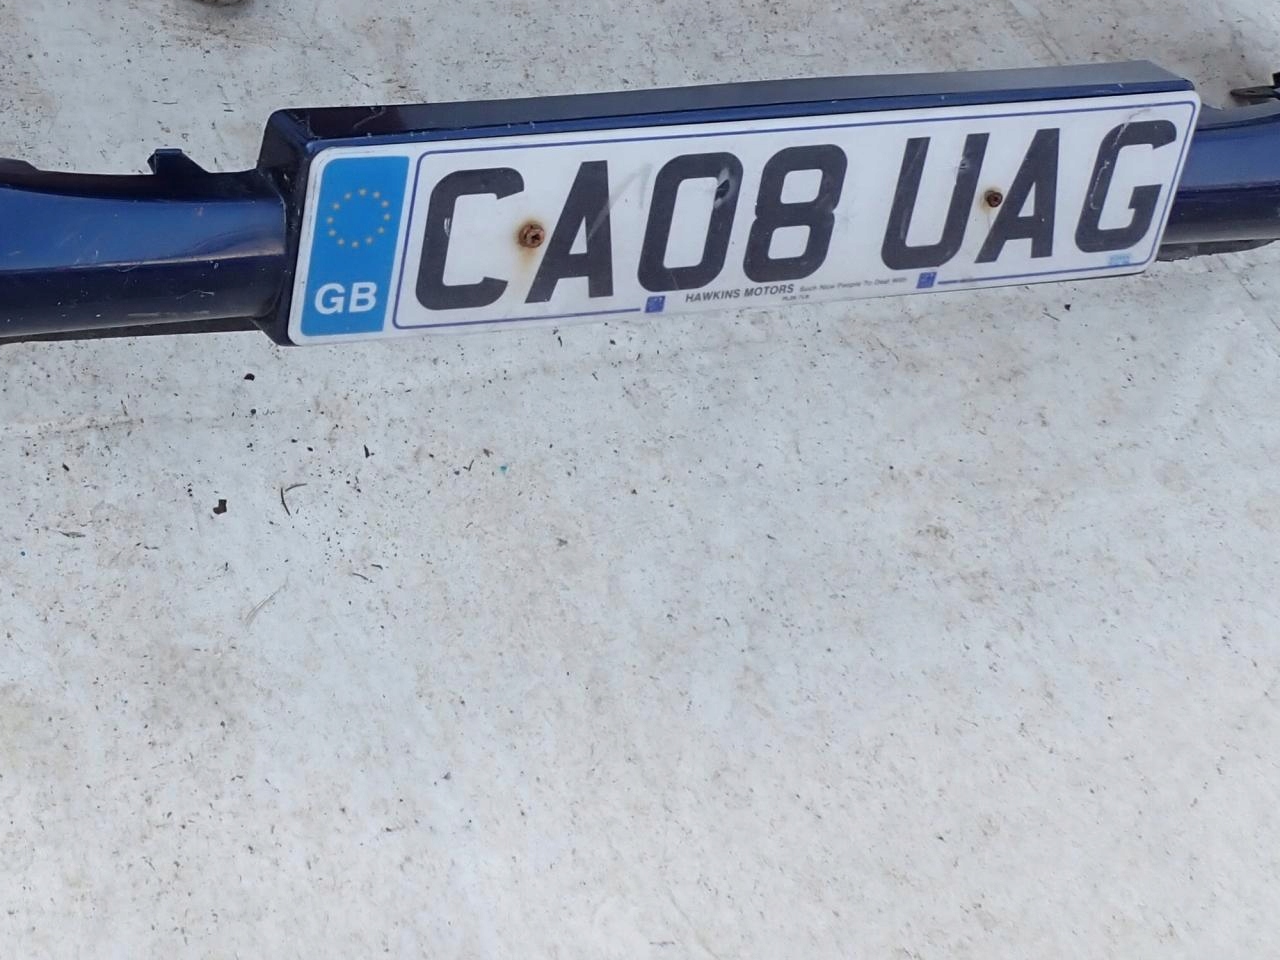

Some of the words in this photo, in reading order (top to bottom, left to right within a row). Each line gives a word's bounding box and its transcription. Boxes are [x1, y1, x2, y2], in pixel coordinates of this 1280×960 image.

[415, 143, 848, 310] CA08
[881, 119, 1178, 271] UAG
[314, 281, 378, 315] GB
[685, 289, 740, 303] HAWKINS
[744, 283, 795, 298] MOTORS
